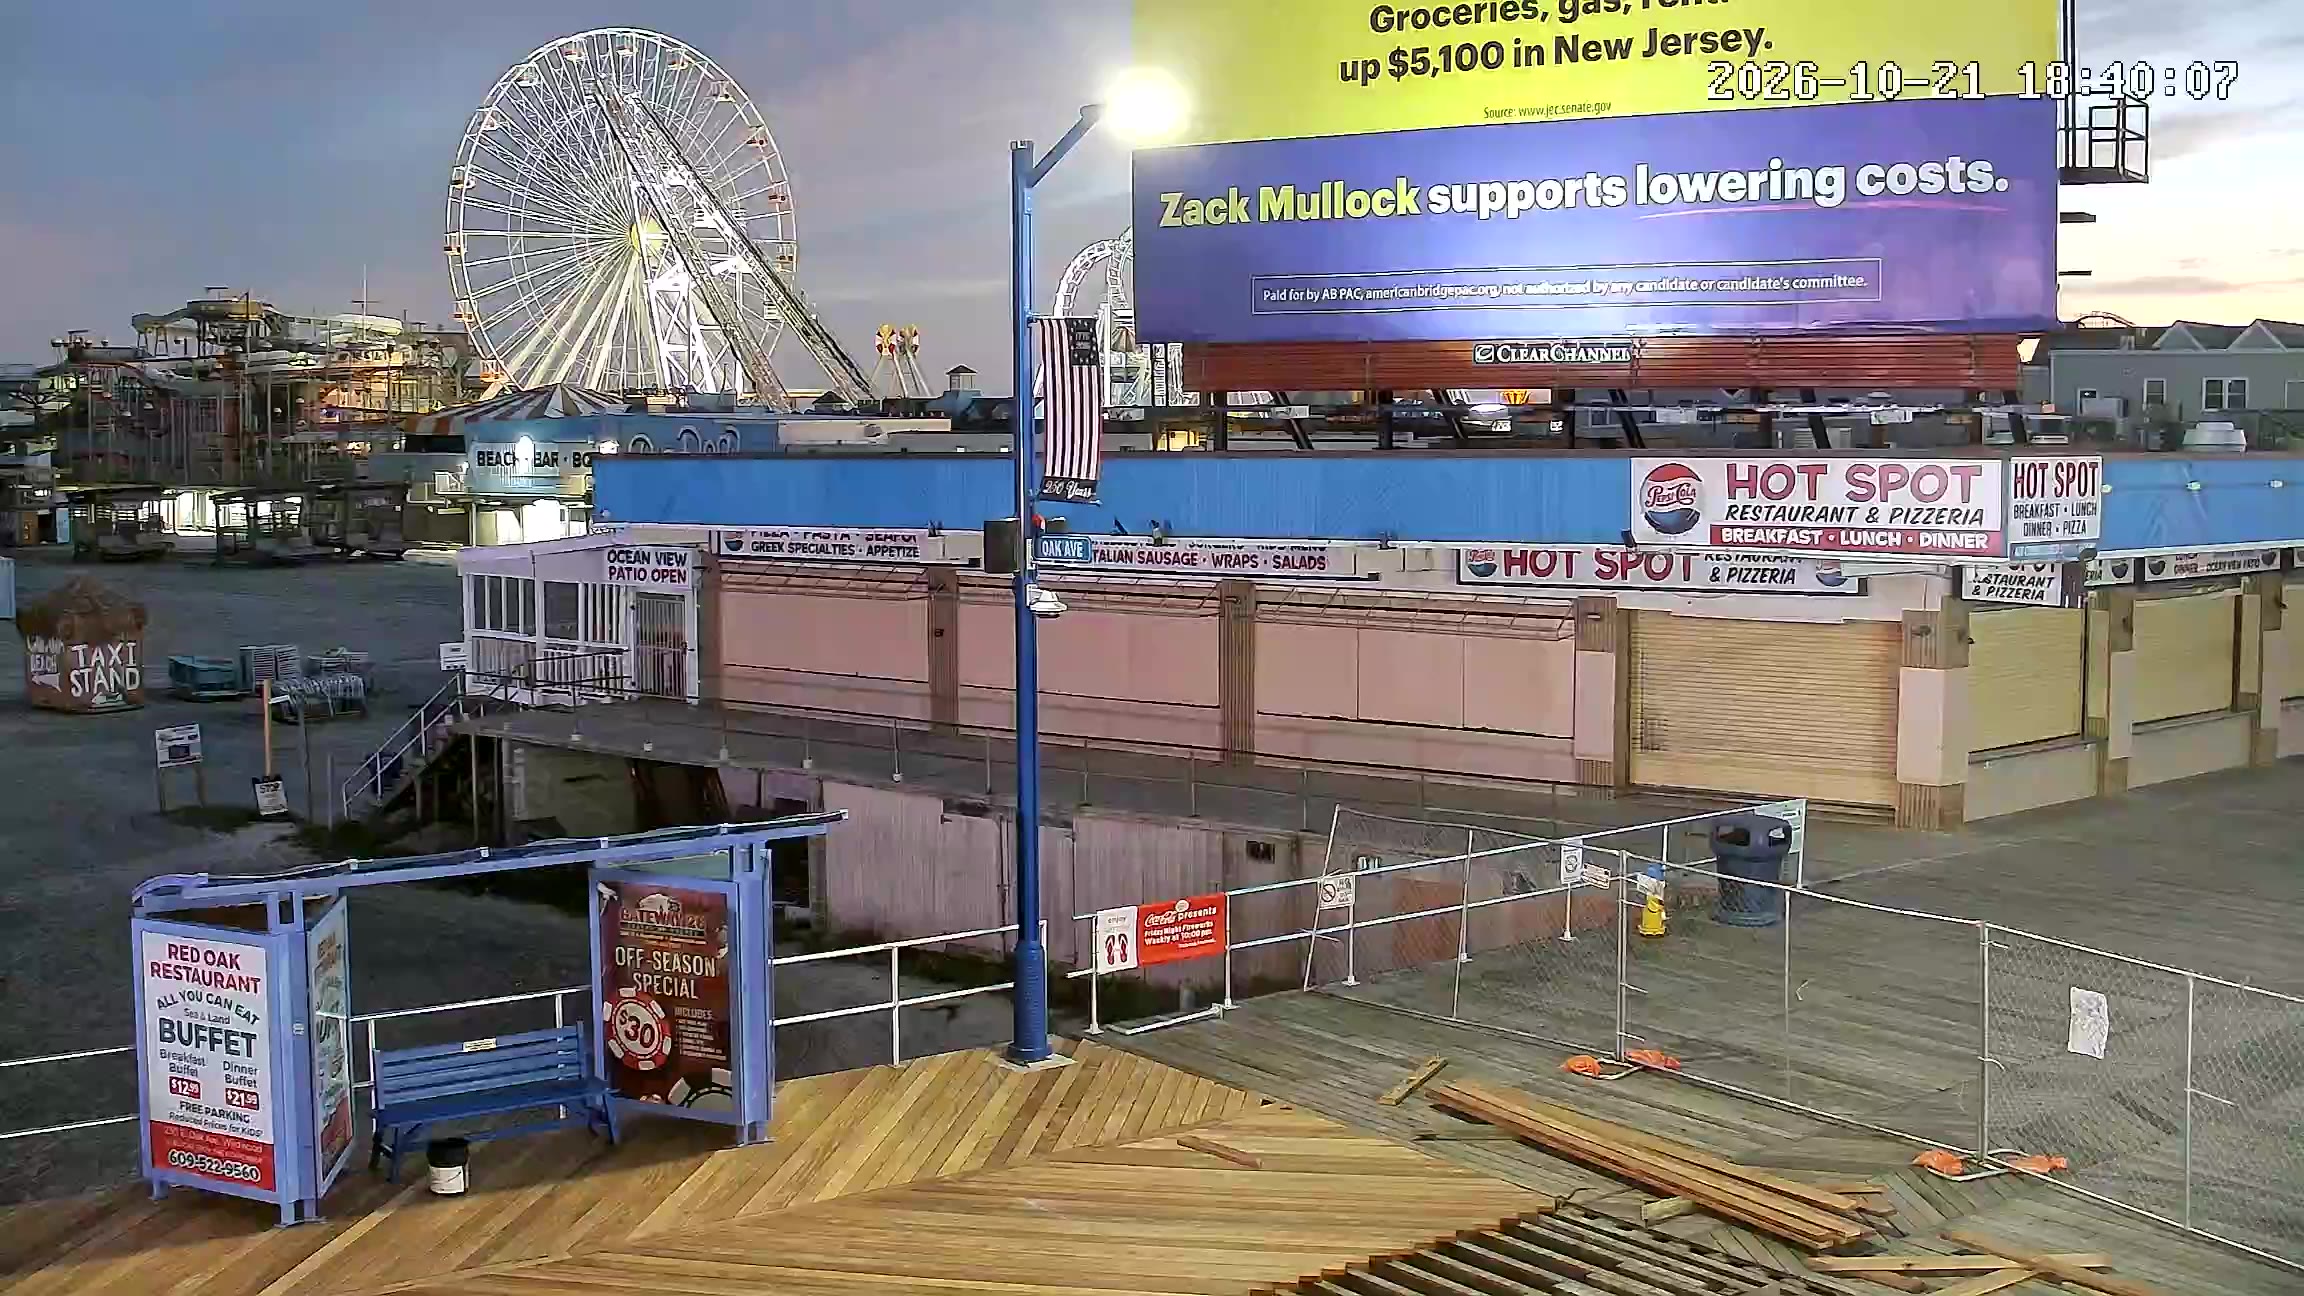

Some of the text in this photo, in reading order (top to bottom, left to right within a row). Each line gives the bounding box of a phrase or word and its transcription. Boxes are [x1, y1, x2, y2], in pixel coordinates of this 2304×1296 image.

[1370, 0, 1631, 33] Groceries, gas,
[1340, 27, 1773, 86] up $5,100 in New Jersey.
[1484, 107, 1516, 118] Source:
[1158, 156, 2009, 228] Zack Mullock supports lowering costs.
[1263, 289, 1287, 301] Paid
[1289, 289, 1304, 300] for
[1305, 288, 1321, 302] by
[1322, 288, 1338, 300] AB
[1502, 281, 1524, 295] not
[1592, 280, 1609, 297] by
[1610, 281, 1633, 296] any
[1635, 278, 1698, 293] candidate
[1700, 281, 1716, 291] or
[1717, 276, 1790, 291] candidate's
[1792, 274, 1869, 290] committee.
[533, 452, 559, 467] BAR
[1043, 480, 1064, 494] 250
[1726, 463, 1983, 504] HOT SPOT
[2014, 462, 2098, 499] HOT SPOT
[1725, 505, 1984, 526] RESTAURANT & PIZZERIA
[2014, 501, 2097, 520] BREAKFAST LUNCH
[1721, 528, 1988, 549] BREAKFAST LUNCH DINNER
[2023, 520, 2087, 536] DINNER PIZZA
[607, 549, 687, 567] OCEAN VIEW
[751, 541, 785, 553] GREEK
[787, 542, 855, 556] SPECIALTIES
[1042, 540, 1062, 557] OAK
[1064, 541, 1083, 558] AVE
[1091, 551, 1327, 571] TALIAN SAUSAGE WRAPS SALADS
[1503, 549, 1700, 583] HOT SPOT
[608, 566, 687, 584] PATIO OPEN
[1709, 566, 1797, 585] & PIZZERIA
[1974, 573, 2056, 588] STAURANT
[1972, 585, 2046, 601] & PIZZERIA
[71, 642, 137, 668] TAXI
[70, 667, 141, 697] STAND
[168, 943, 241, 971] RED OAK
[615, 946, 716, 978] OFF-SEASON
[150, 962, 261, 994] RESTAURANT
[633, 972, 699, 1000] SPECIAL
[157, 990, 260, 1026] ALL YOU CAN EAT
[184, 1008, 199, 1019] Sea
[207, 1012, 231, 1025] Land
[159, 1018, 257, 1058] BUFFET
[620, 1009, 655, 1048] $30
[160, 1049, 206, 1067] Breakfast
[223, 1061, 259, 1076] Dinner
[169, 1063, 199, 1077] Buffet
[225, 1074, 258, 1089] Buffet
[180, 1101, 251, 1124] FREE PARKING
[168, 1149, 262, 1182] 609-522-9560
